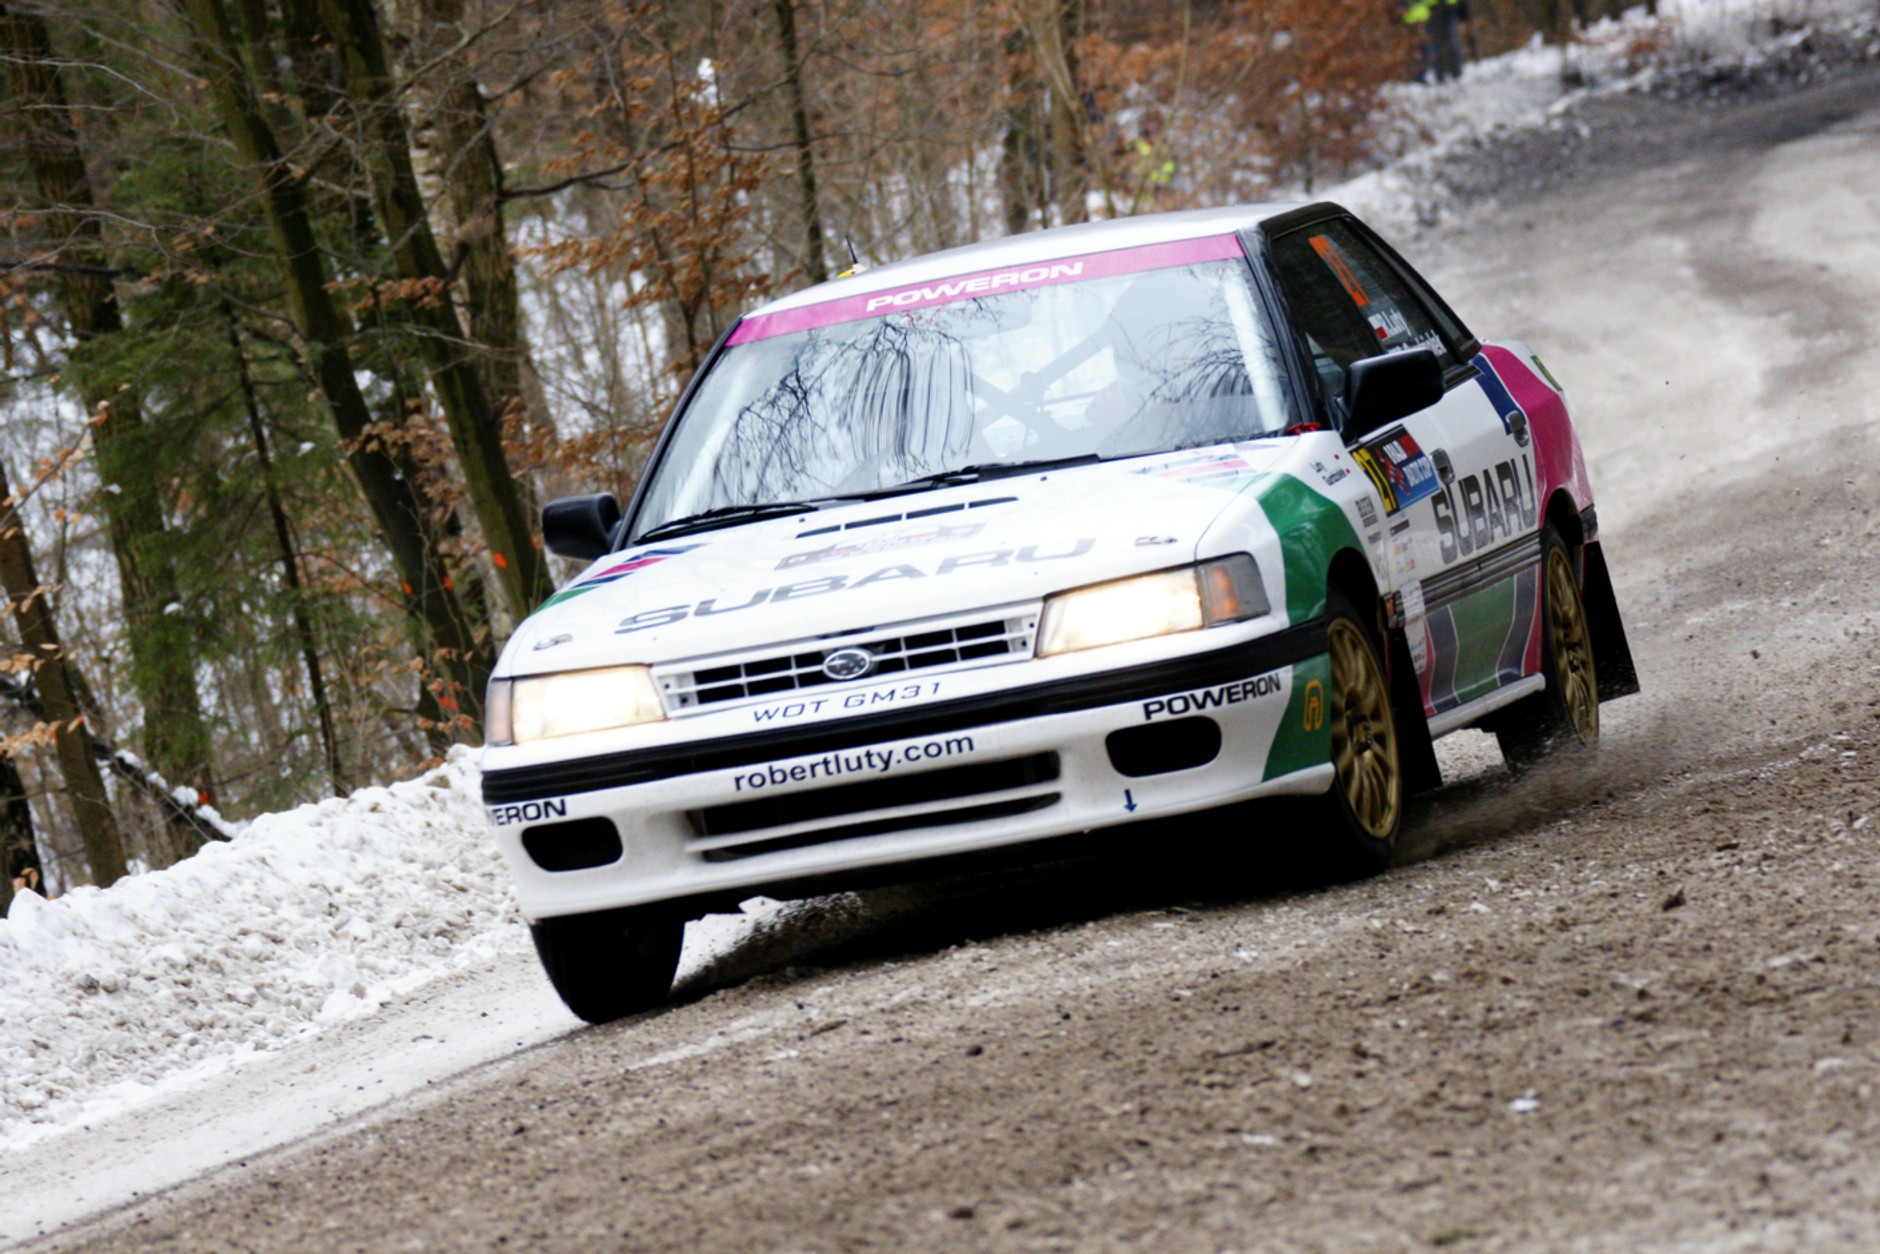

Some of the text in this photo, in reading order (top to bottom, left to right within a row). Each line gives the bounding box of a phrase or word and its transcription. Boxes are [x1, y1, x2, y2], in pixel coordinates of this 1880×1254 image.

[865, 261, 1084, 312] POWERON
[1431, 453, 1537, 565] SUBARU
[613, 537, 1097, 635] SUBARU
[753, 682, 941, 723] WOT GM31
[1142, 673, 1282, 721] POWERON
[734, 735, 975, 792] robertluty.com
[487, 798, 567, 826] ERON
